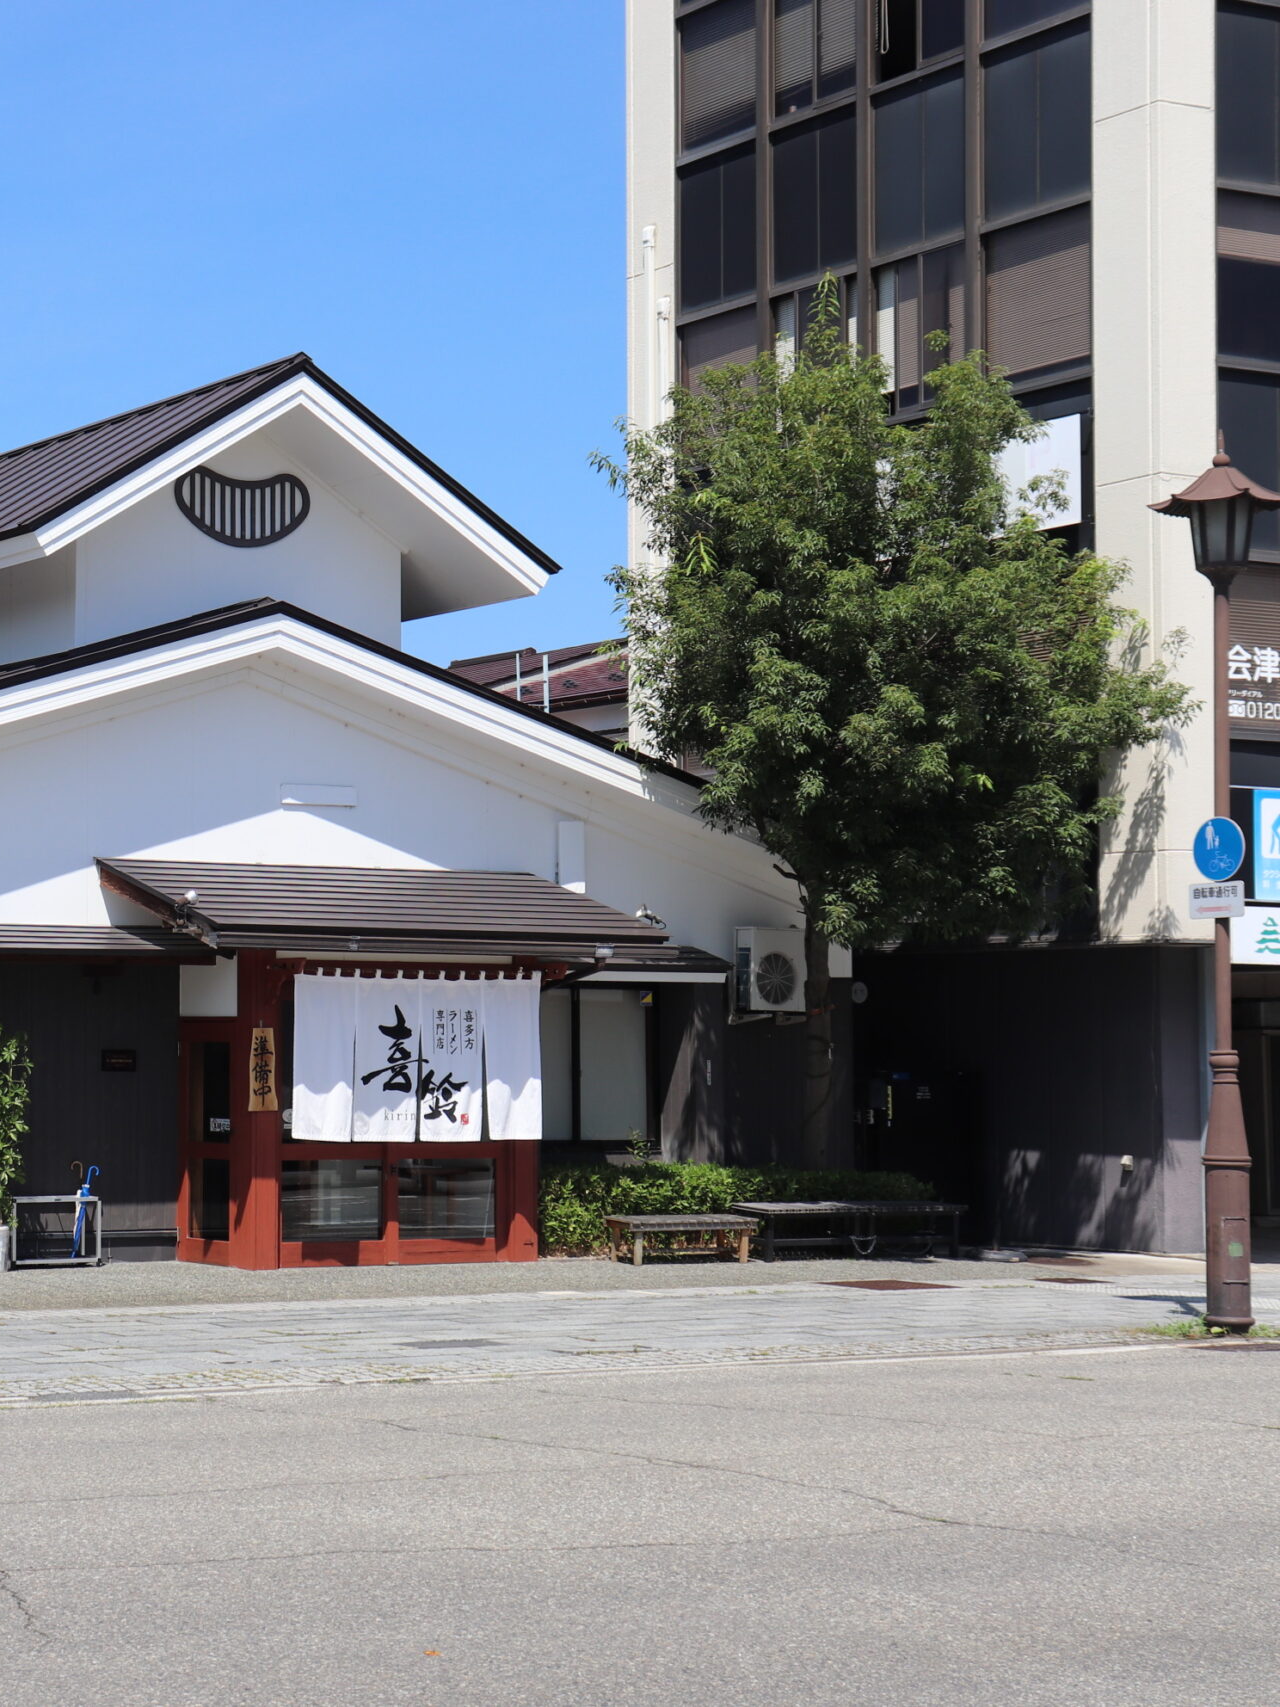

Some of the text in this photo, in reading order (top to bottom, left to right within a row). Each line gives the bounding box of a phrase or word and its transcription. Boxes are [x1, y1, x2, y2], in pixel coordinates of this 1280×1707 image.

[1228, 644, 1280, 683] 会津
[1247, 701, 1280, 720] 0120
[1193, 885, 1238, 899] 自転車通行可
[435, 1010, 445, 1050] 専門店
[448, 1010, 459, 1055] ラーメン
[463, 1009, 475, 1050] 喜多方
[252, 1035, 273, 1108] 準備中
[384, 1110, 417, 1121] kirin
